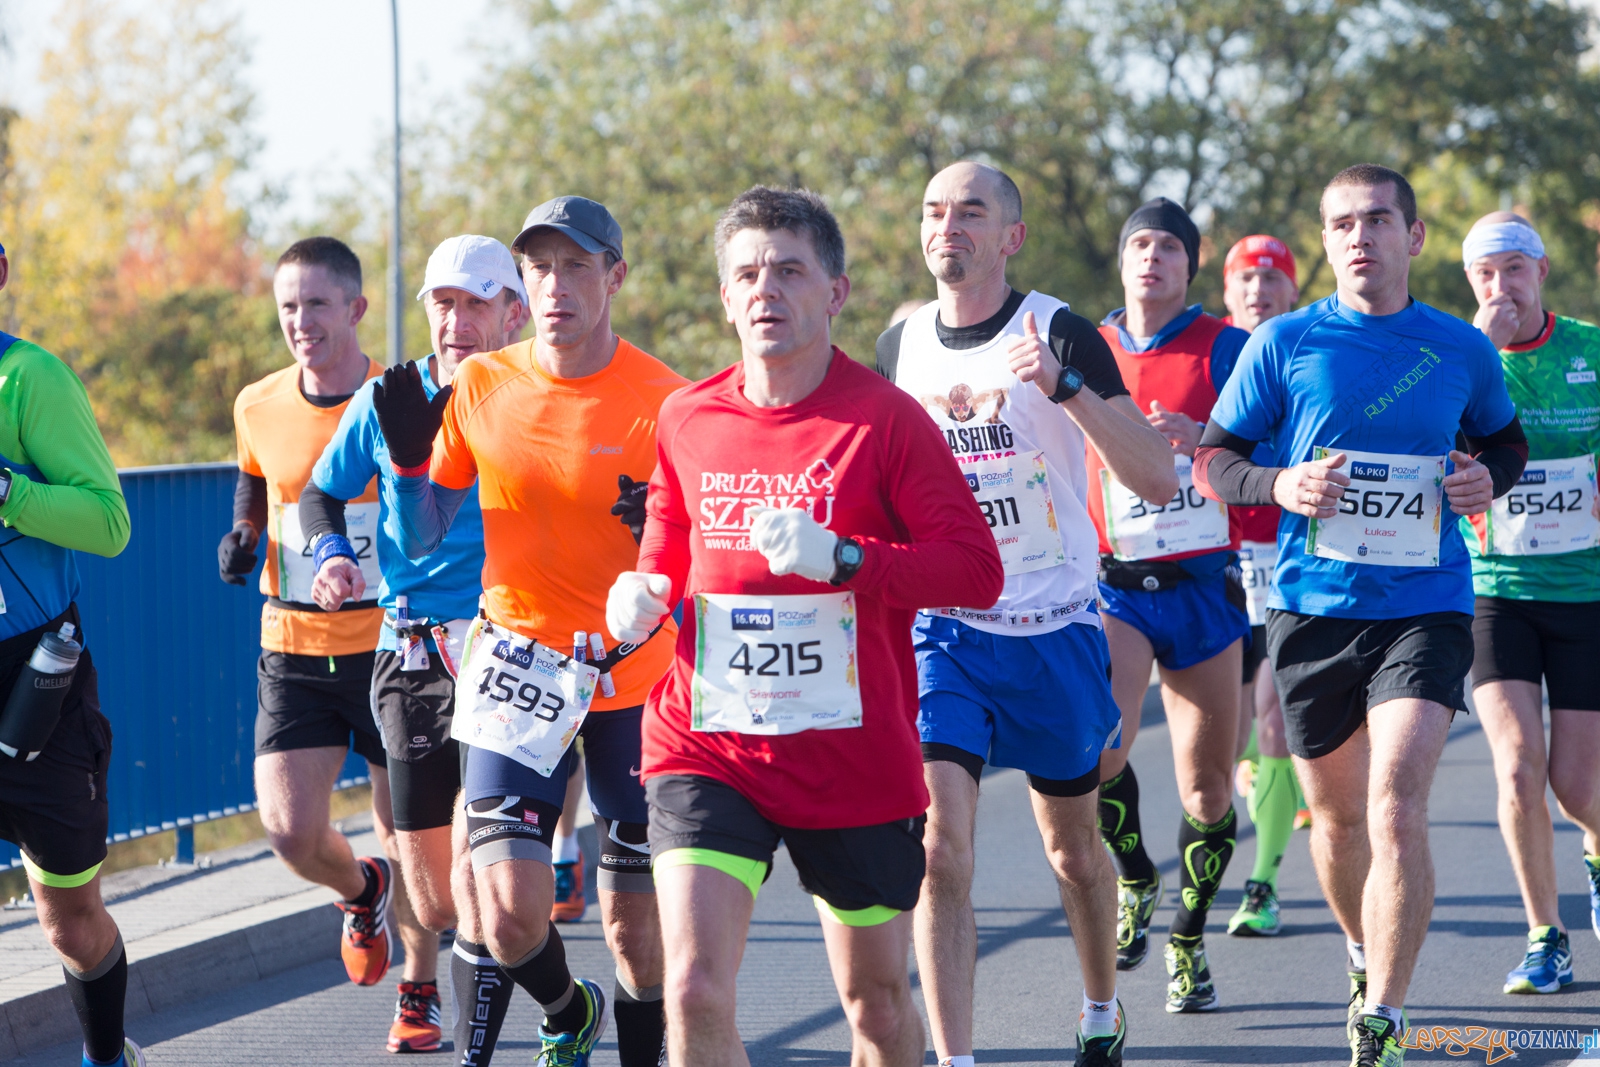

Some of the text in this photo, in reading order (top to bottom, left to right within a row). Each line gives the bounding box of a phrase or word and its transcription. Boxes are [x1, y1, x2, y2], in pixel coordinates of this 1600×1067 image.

[1363, 392, 1394, 420] RUN
[1393, 357, 1435, 398] ADDICT
[1522, 406, 1600, 417] Polskie Towarzystw
[943, 424, 1014, 454] ASHING
[601, 446, 623, 455] asics
[1367, 467, 1386, 477] PKO
[1391, 472, 1419, 480] maraton
[1527, 472, 1544, 482] PKO
[700, 468, 810, 495] DRUŻYNA
[982, 477, 1014, 488] maraton
[1339, 487, 1424, 520] 5674
[1507, 489, 1583, 515] 6542
[1364, 527, 1397, 537] Łukasz
[995, 537, 1019, 546] sław
[749, 613, 771, 626] PKO
[777, 618, 816, 628] maraton
[510, 651, 531, 664] PKO
[728, 640, 823, 676] 4215
[476, 666, 566, 723] 4593
[749, 689, 802, 699] Sławomir
[489, 710, 513, 724] Artur
